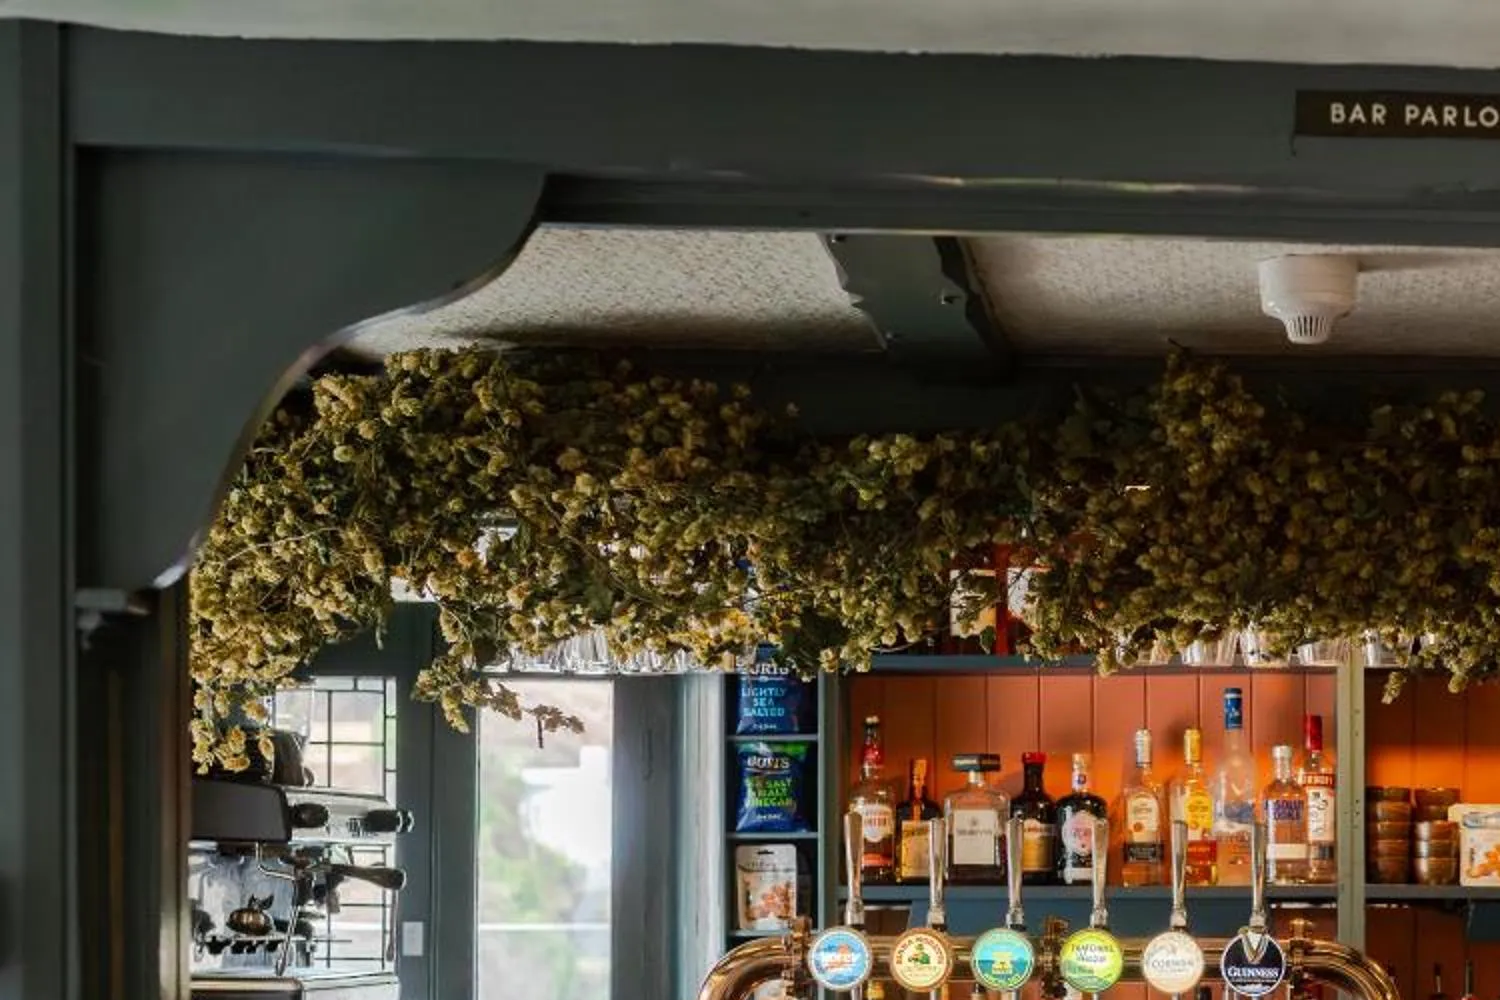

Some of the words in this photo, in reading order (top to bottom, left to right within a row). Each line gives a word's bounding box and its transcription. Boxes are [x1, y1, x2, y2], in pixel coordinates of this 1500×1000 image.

[1330, 103, 1387, 125] BAR
[741, 687, 786, 697] LIGHTLY
[753, 697, 775, 707] SEA
[743, 707, 785, 717] SALTED
[1227, 965, 1279, 977] GUINNESS
